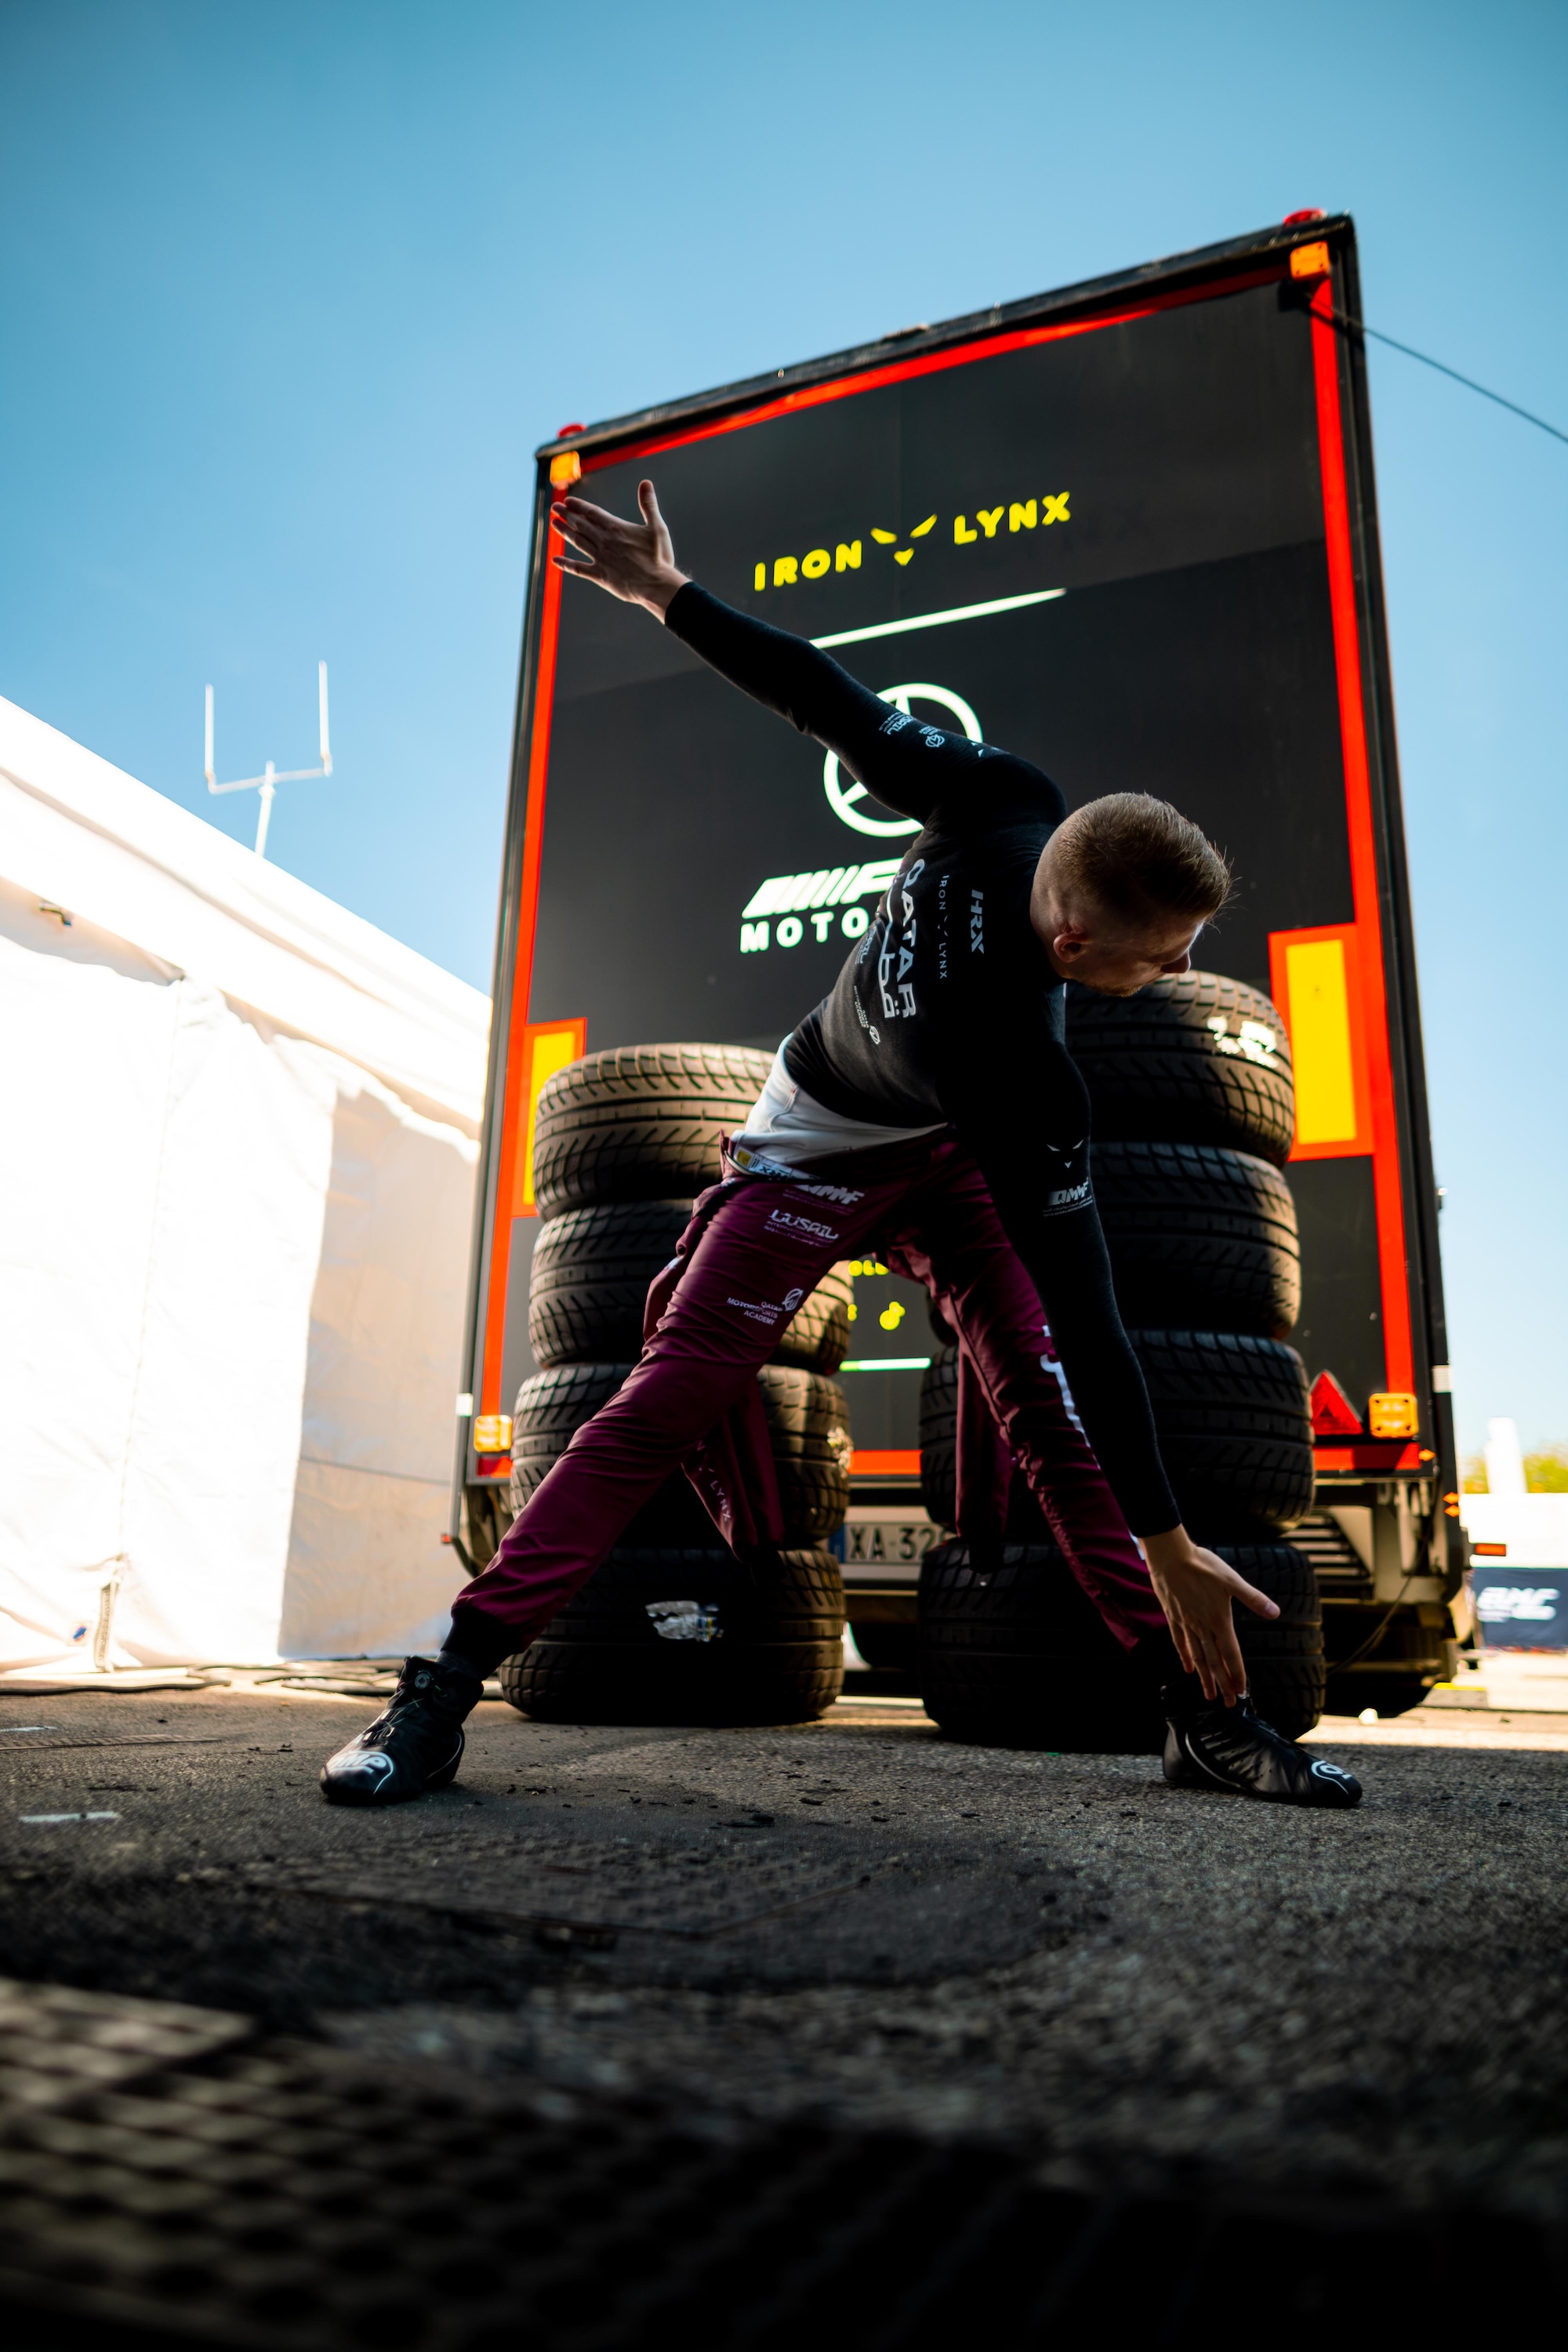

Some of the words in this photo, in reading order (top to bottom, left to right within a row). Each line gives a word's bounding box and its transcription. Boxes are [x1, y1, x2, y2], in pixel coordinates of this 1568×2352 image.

[754, 539, 862, 592] IRON
[953, 491, 1072, 546] LYNX
[938, 874, 949, 910] IRON
[895, 858, 926, 1018] QATAR
[971, 889, 985, 955] HRX
[938, 942, 948, 979] LYNX
[768, 1209, 839, 1240] LUSAIL
[743, 1310, 775, 1326] ACADEMY
[850, 1527, 886, 1560] XA
[899, 1526, 946, 1560] 32
